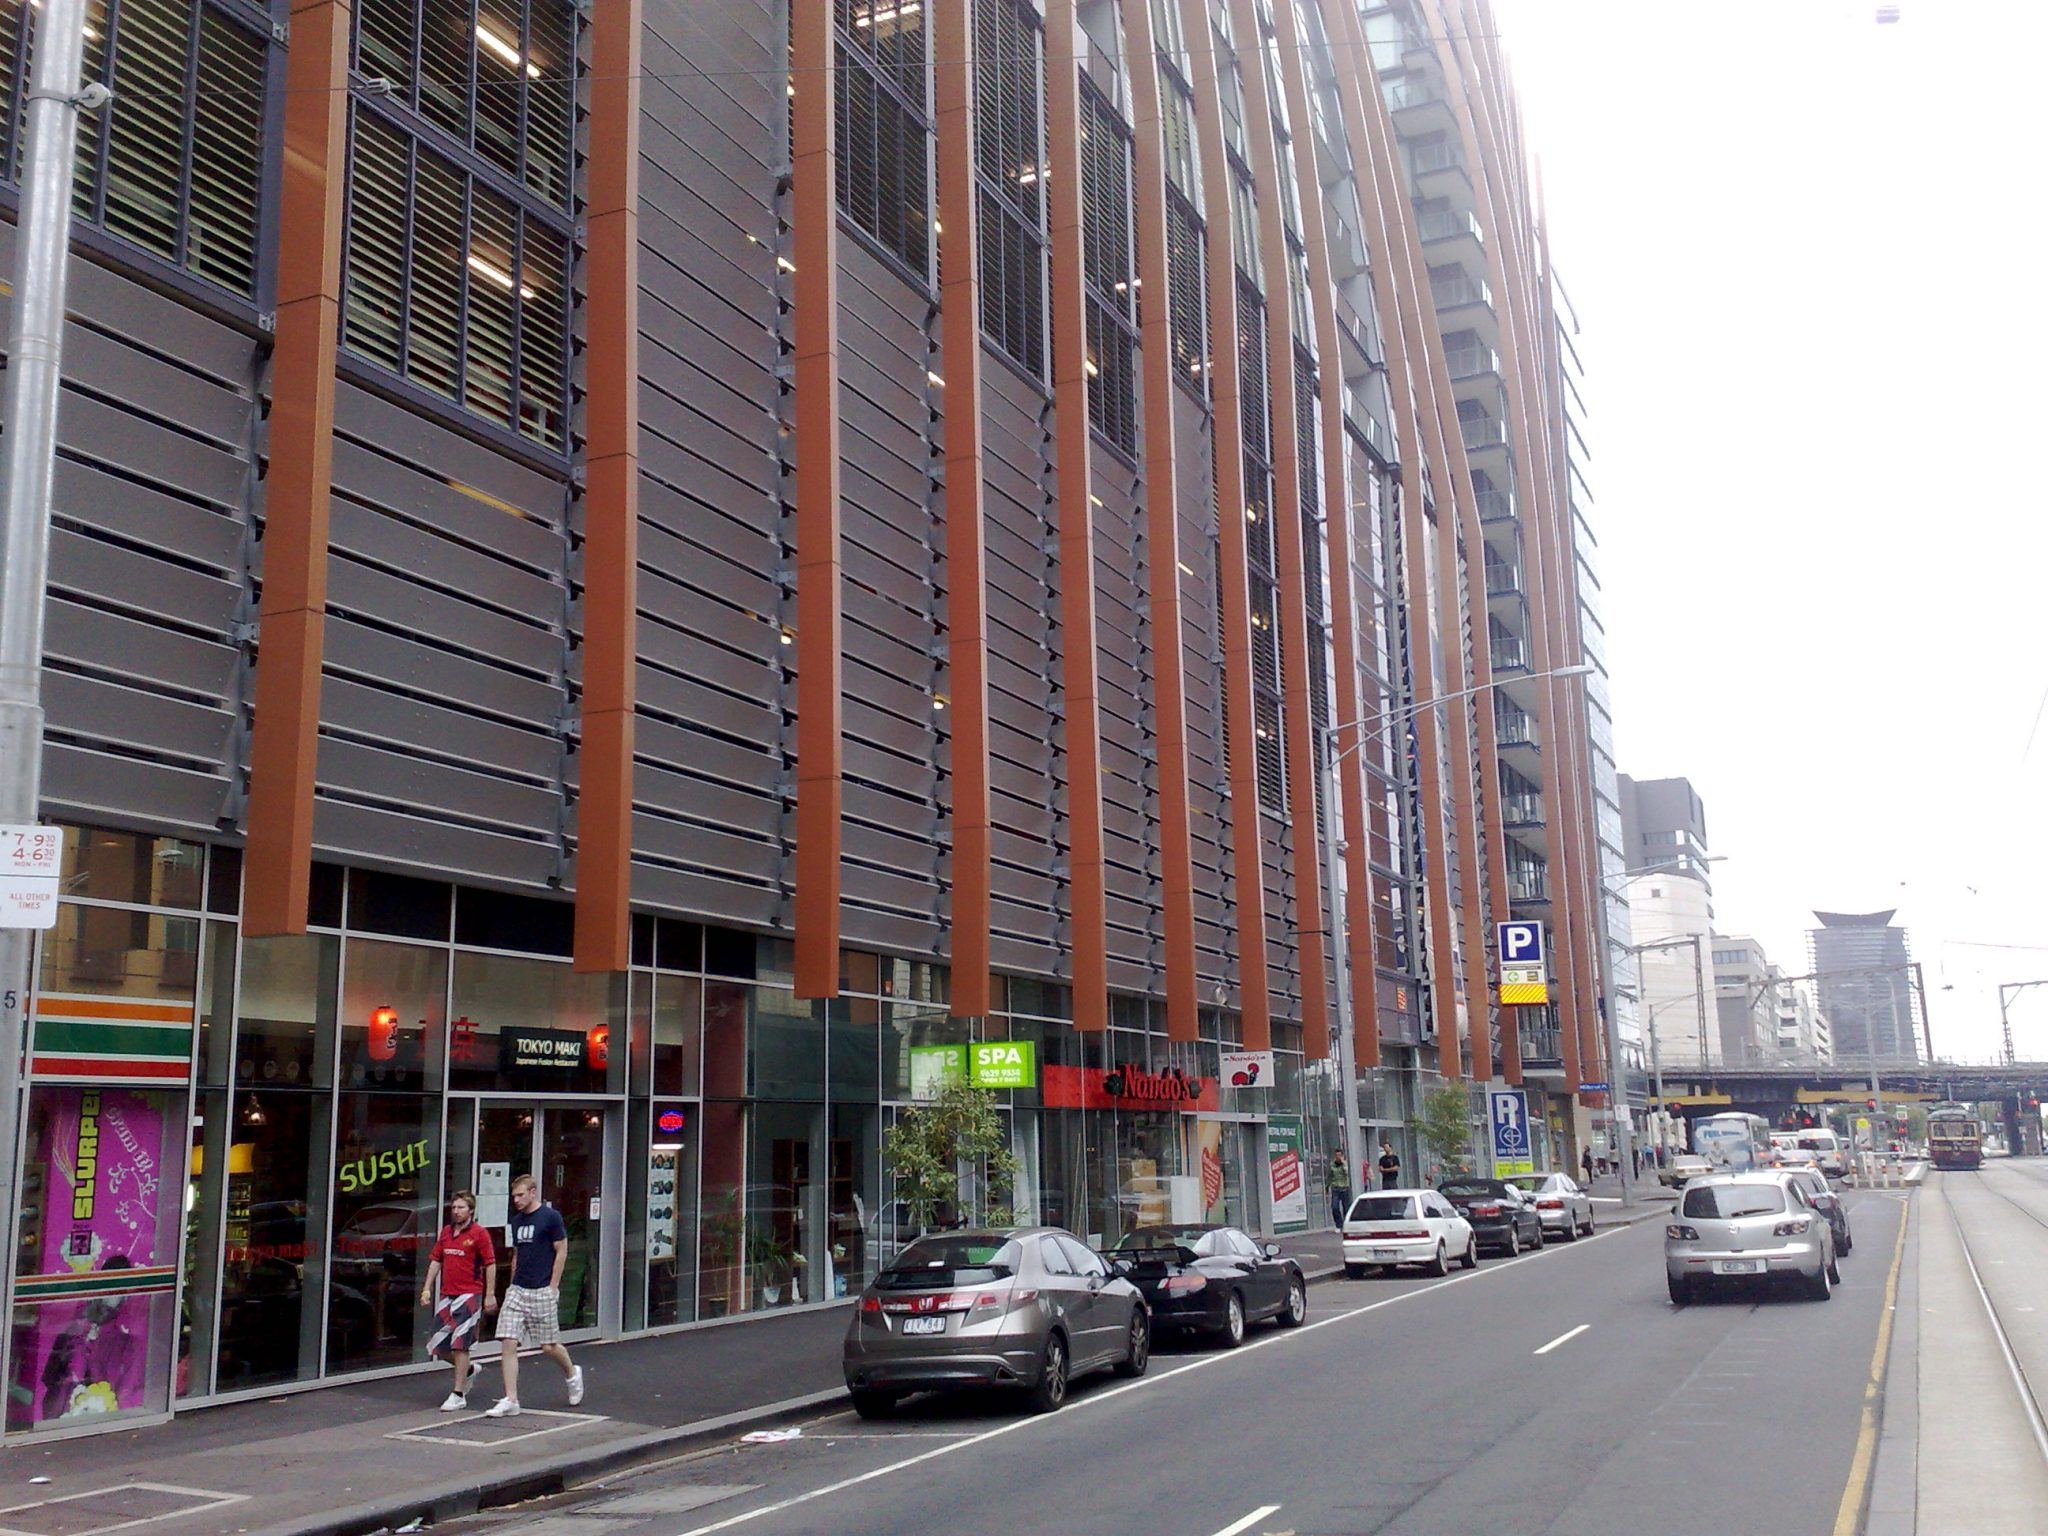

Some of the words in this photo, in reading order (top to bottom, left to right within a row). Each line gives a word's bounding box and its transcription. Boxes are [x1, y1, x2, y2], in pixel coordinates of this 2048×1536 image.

[25, 893, 50, 901] OTHER
[1507, 927, 1532, 958] P
[4, 990, 16, 1009] 5
[516, 1038, 553, 1054] TOKYO
[555, 1041, 582, 1056] MAKI
[978, 1047, 1021, 1066] SPA
[1228, 1054, 1261, 1062] Nando's
[1121, 1062, 1191, 1100] Nando's
[340, 1139, 430, 1192] SUSHI
